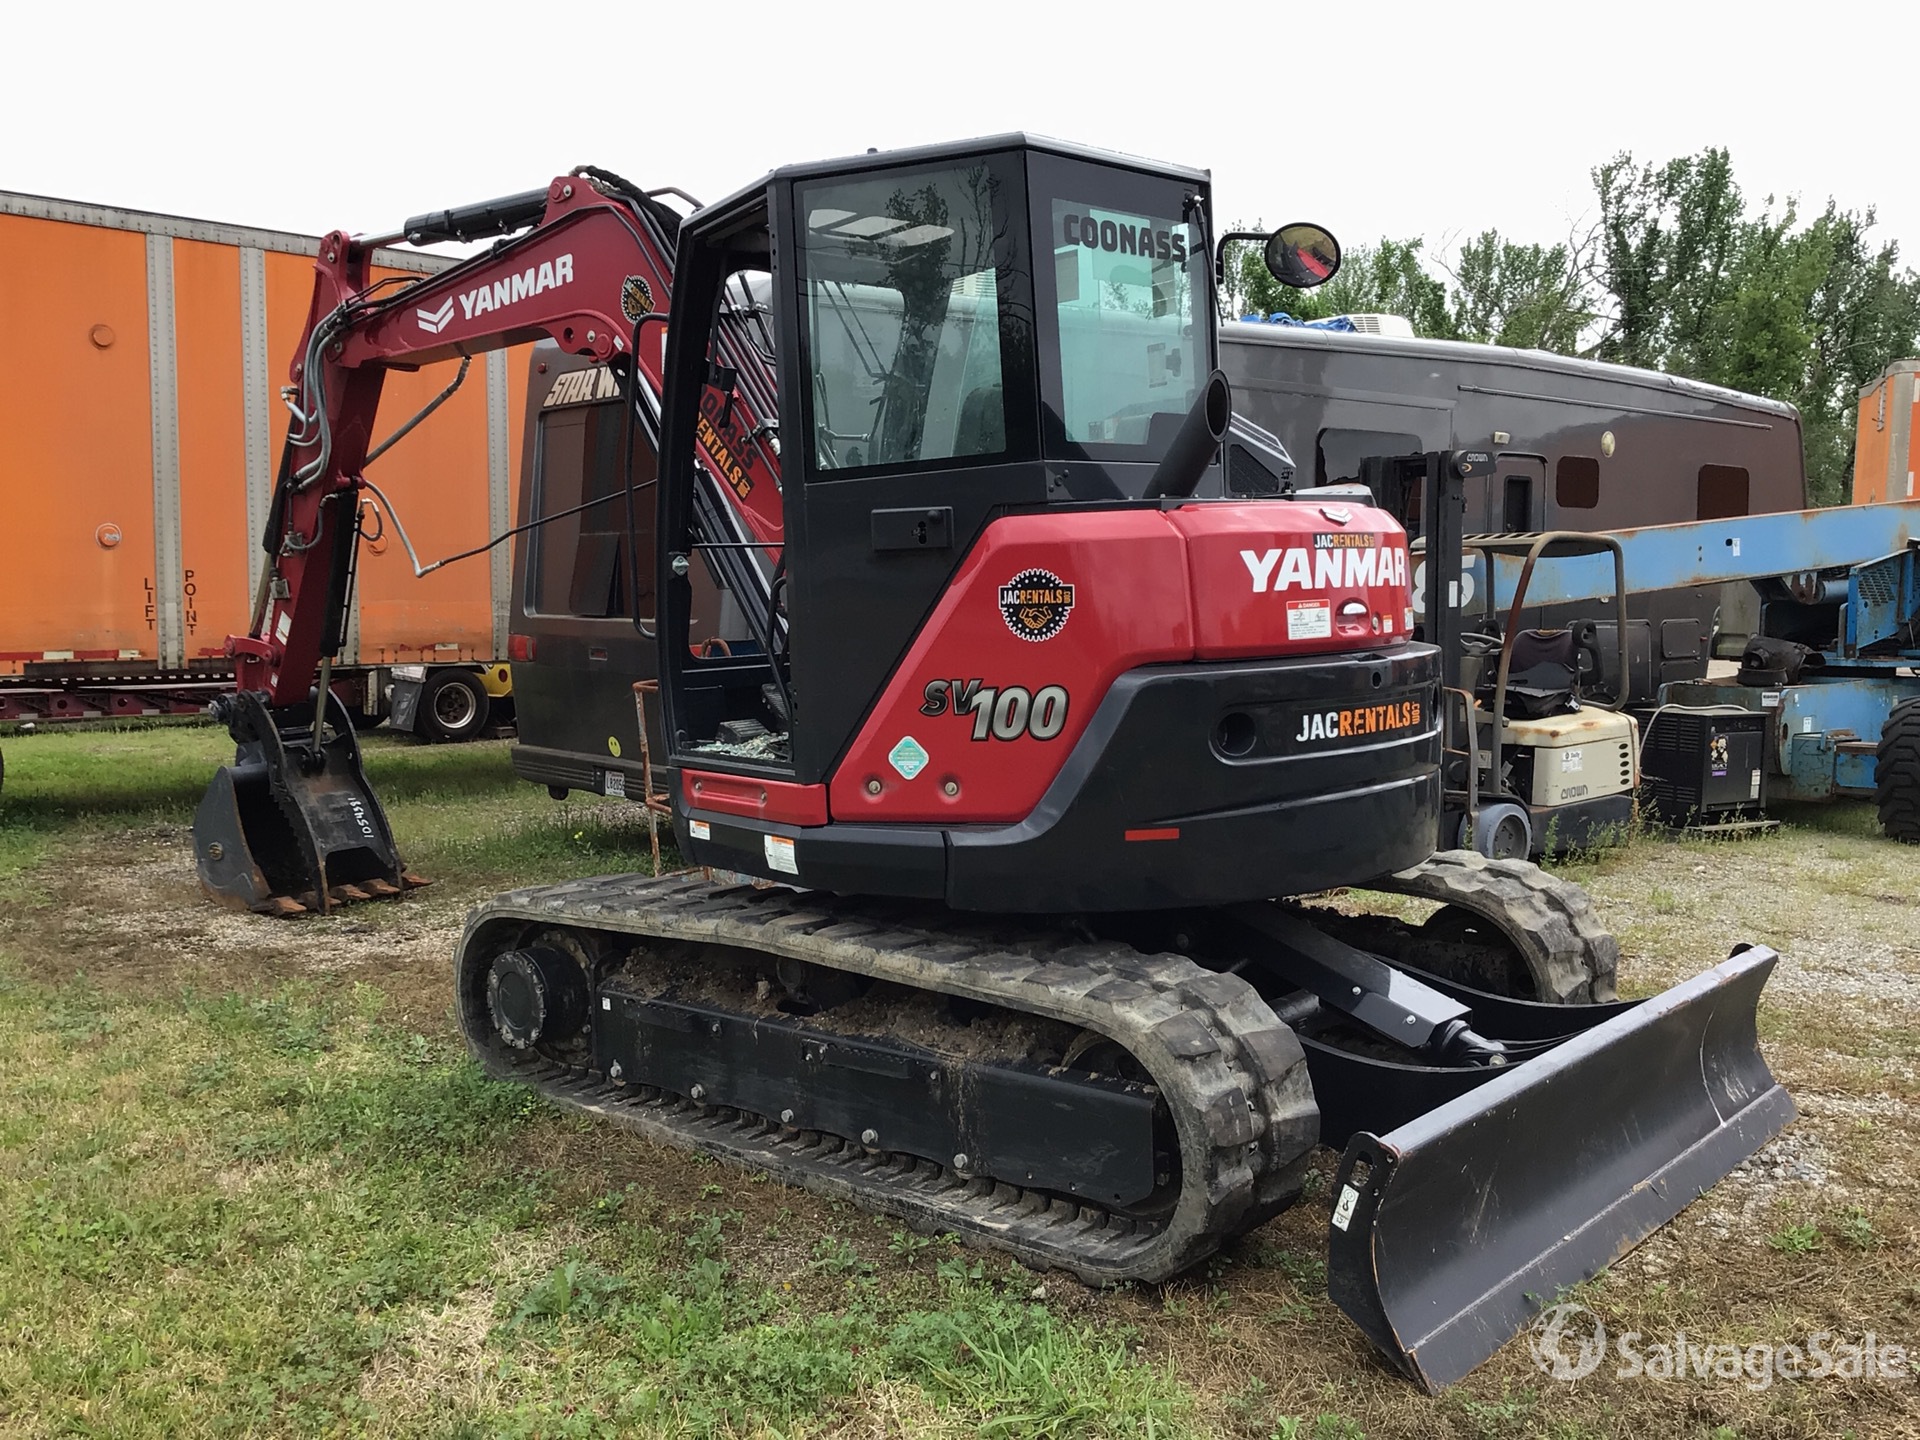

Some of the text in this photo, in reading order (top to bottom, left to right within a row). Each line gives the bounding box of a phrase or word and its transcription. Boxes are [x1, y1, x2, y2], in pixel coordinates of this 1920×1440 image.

[1063, 213, 1187, 263] COONASS
[458, 253, 574, 321] YANMAR
[543, 367, 599, 408] STAR
[696, 411, 743, 485] ENTALS
[1239, 547, 1406, 593] YANMAR
[144, 569, 198, 636] LIFT POINT
